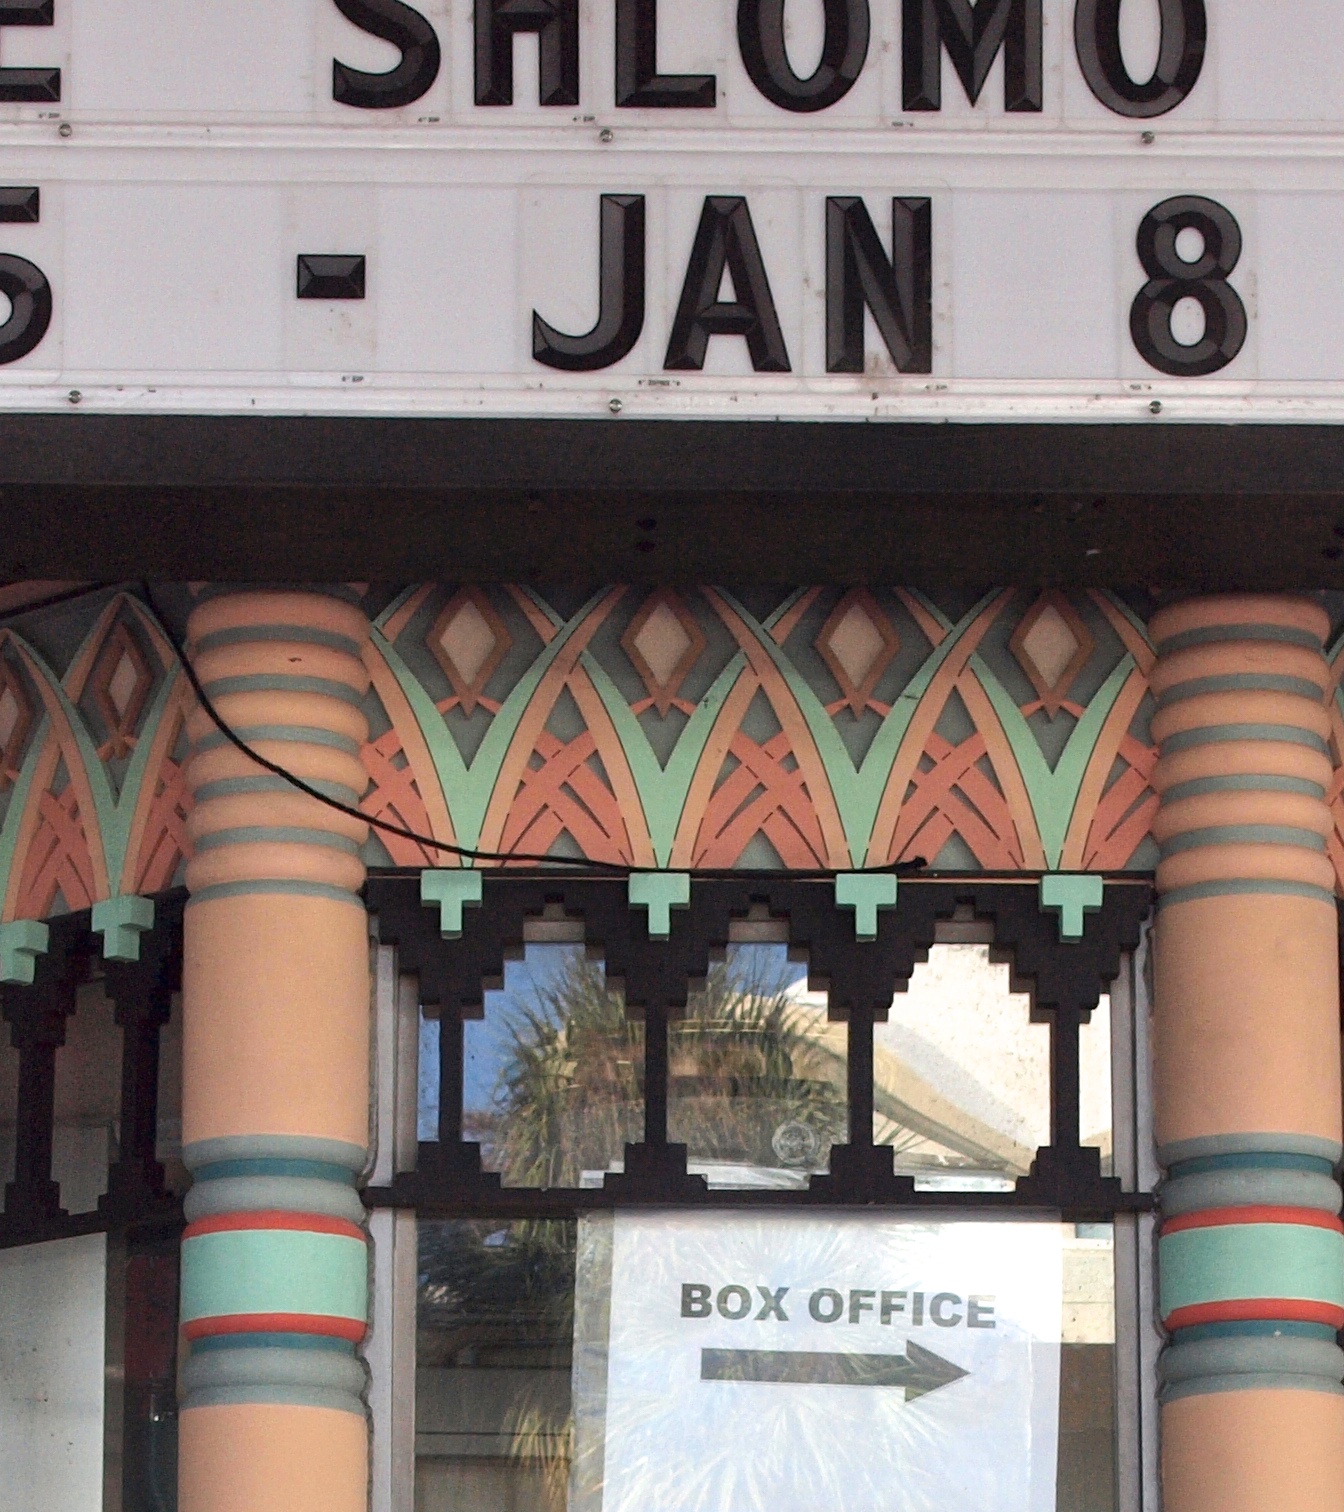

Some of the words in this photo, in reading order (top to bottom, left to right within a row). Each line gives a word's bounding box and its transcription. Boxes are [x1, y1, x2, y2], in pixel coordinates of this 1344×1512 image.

[297, 254, 365, 299] -
[532, 193, 933, 374] JAN
[1128, 195, 1248, 378] 8
[680, 1283, 790, 1322] BOX
[808, 1288, 997, 1329] OFFICE
